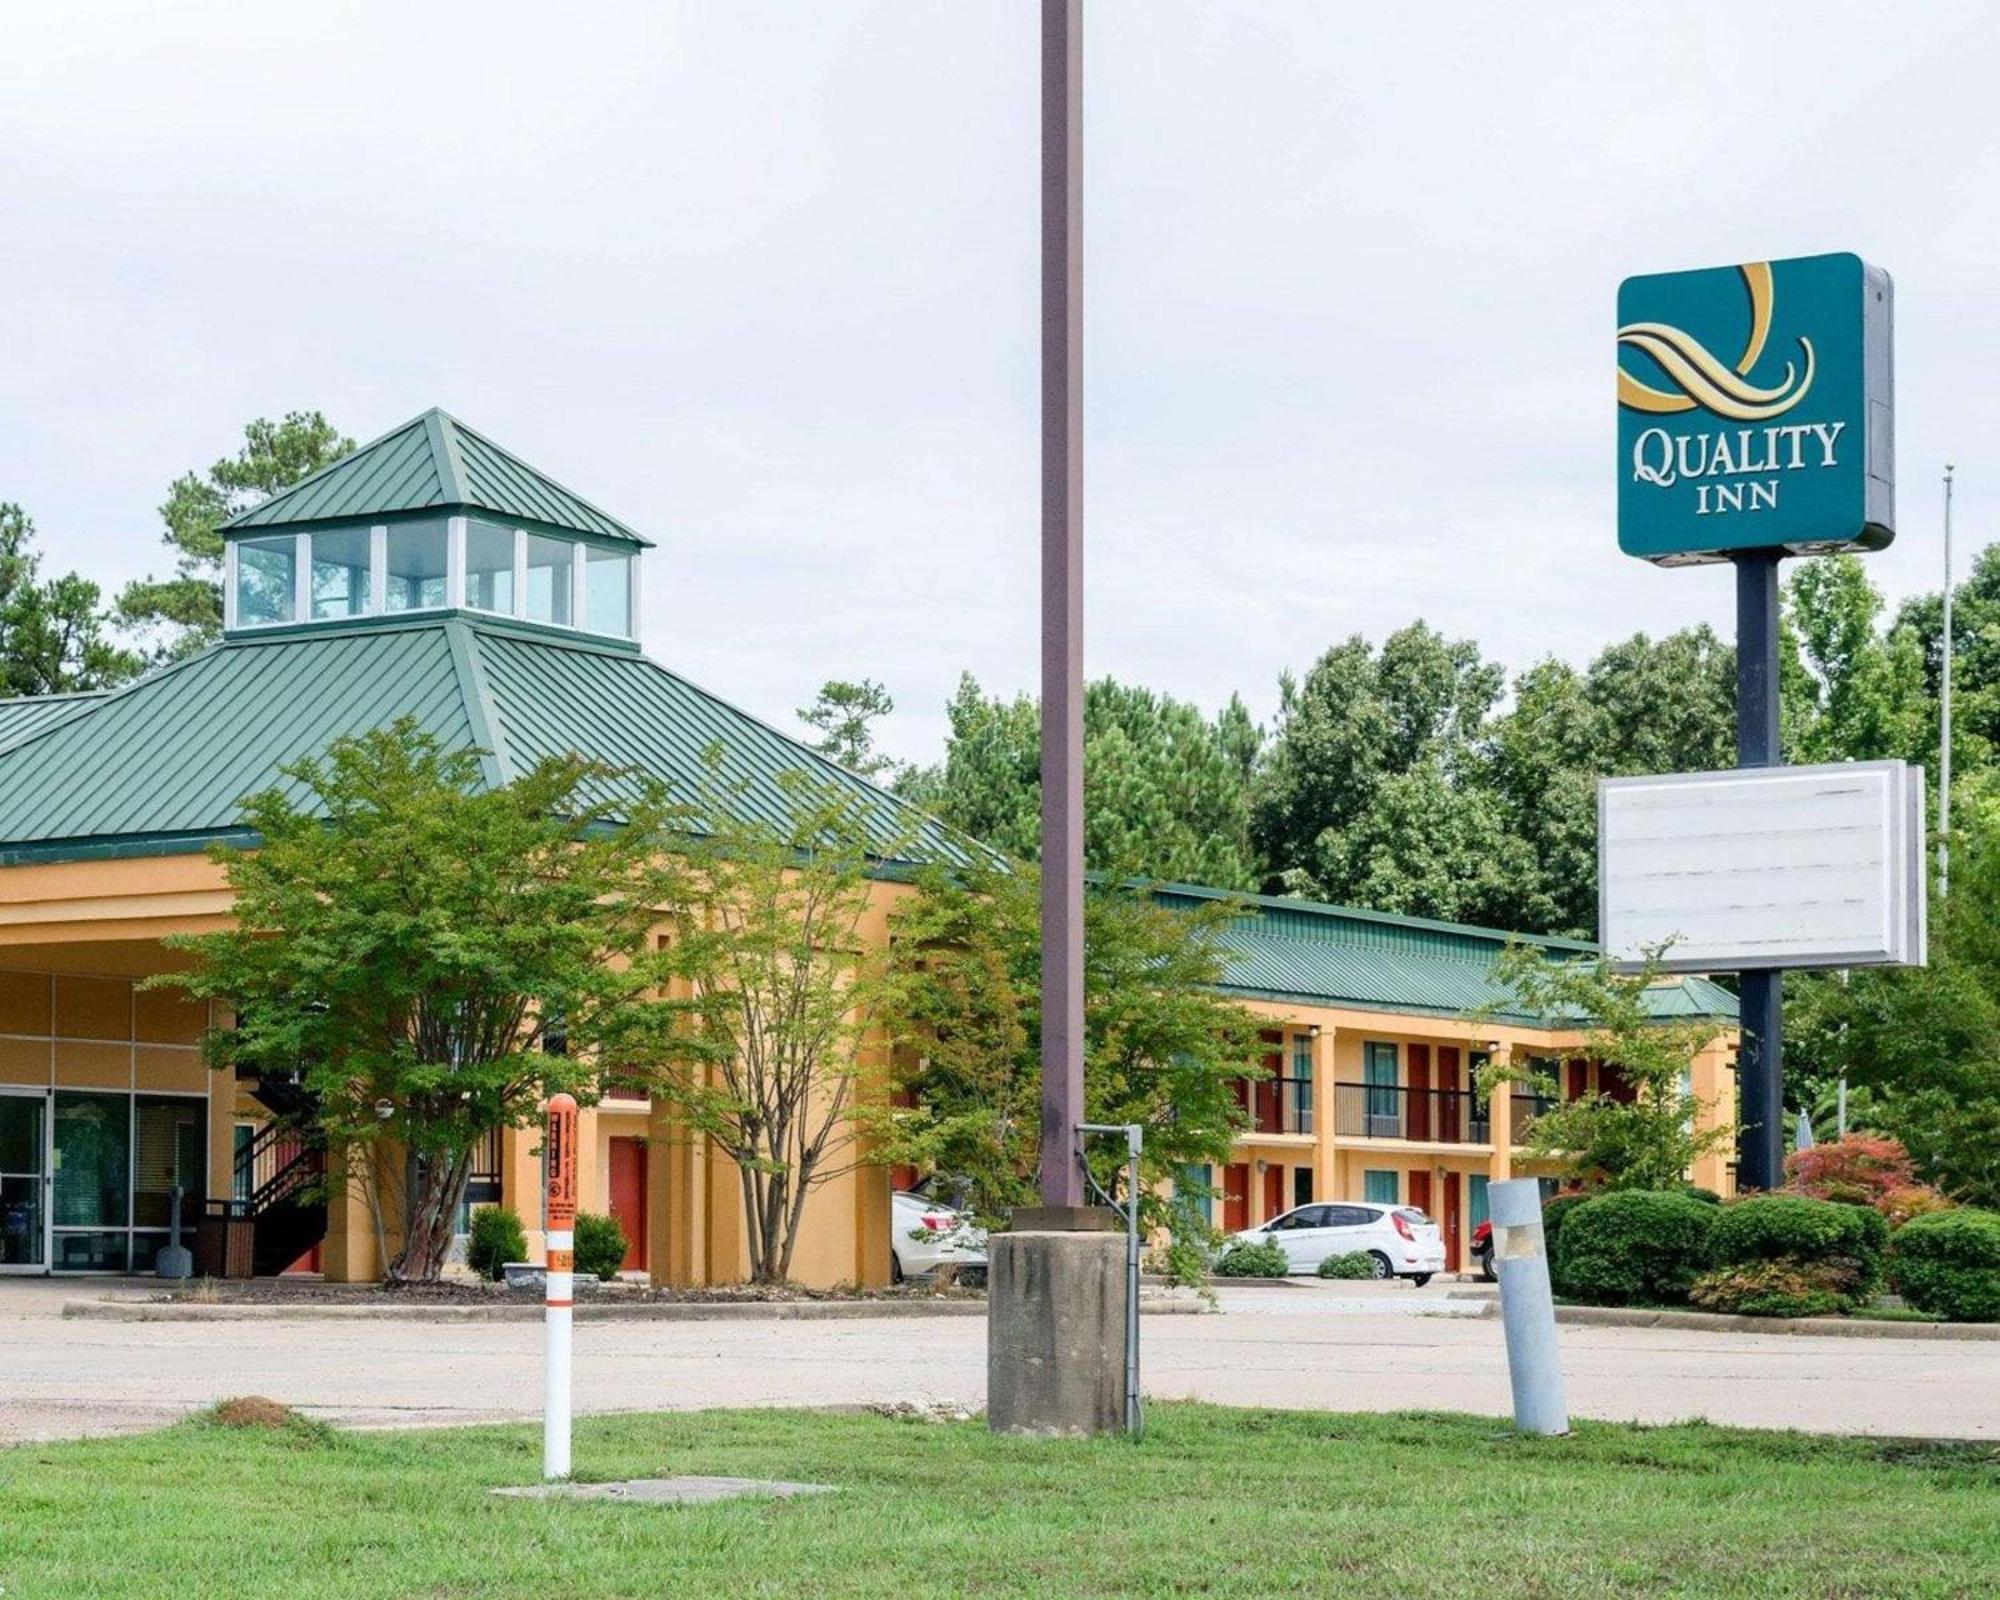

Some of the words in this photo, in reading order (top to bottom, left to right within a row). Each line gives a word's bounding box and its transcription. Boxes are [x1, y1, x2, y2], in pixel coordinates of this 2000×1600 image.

[1633, 422, 1845, 487] QUALITY
[1696, 480, 1779, 514] INN
[550, 1113, 559, 1177] WARNING
